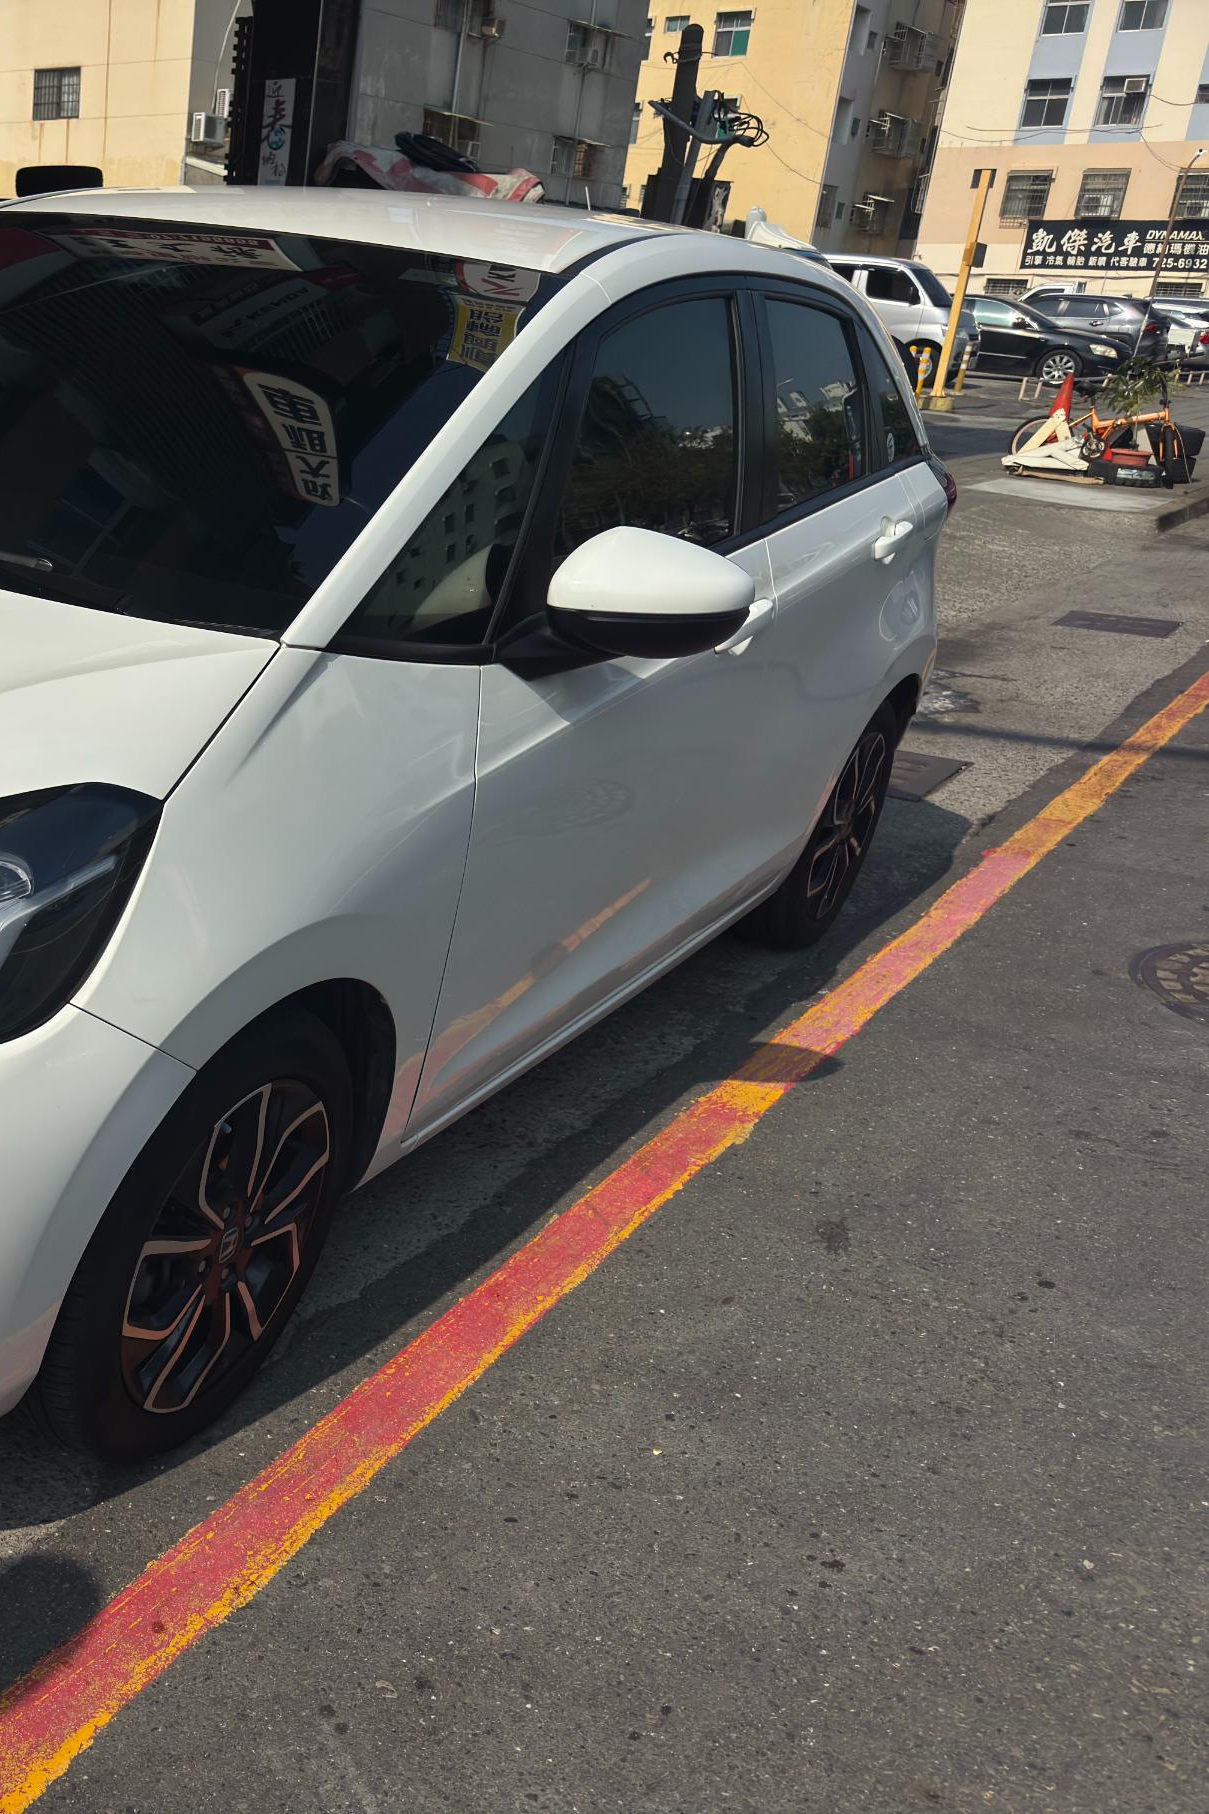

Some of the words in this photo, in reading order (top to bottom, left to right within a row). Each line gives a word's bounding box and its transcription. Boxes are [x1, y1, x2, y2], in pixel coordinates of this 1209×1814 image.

[1027, 228, 1142, 255] 凱傑汽車
[1025, 256, 1042, 266] 引擎
[1045, 256, 1063, 266] 冷氣
[1066, 256, 1085, 266] 輪胎
[1110, 257, 1147, 267] 代客驗車
[1152, 257, 1208, 269] 725-6932
